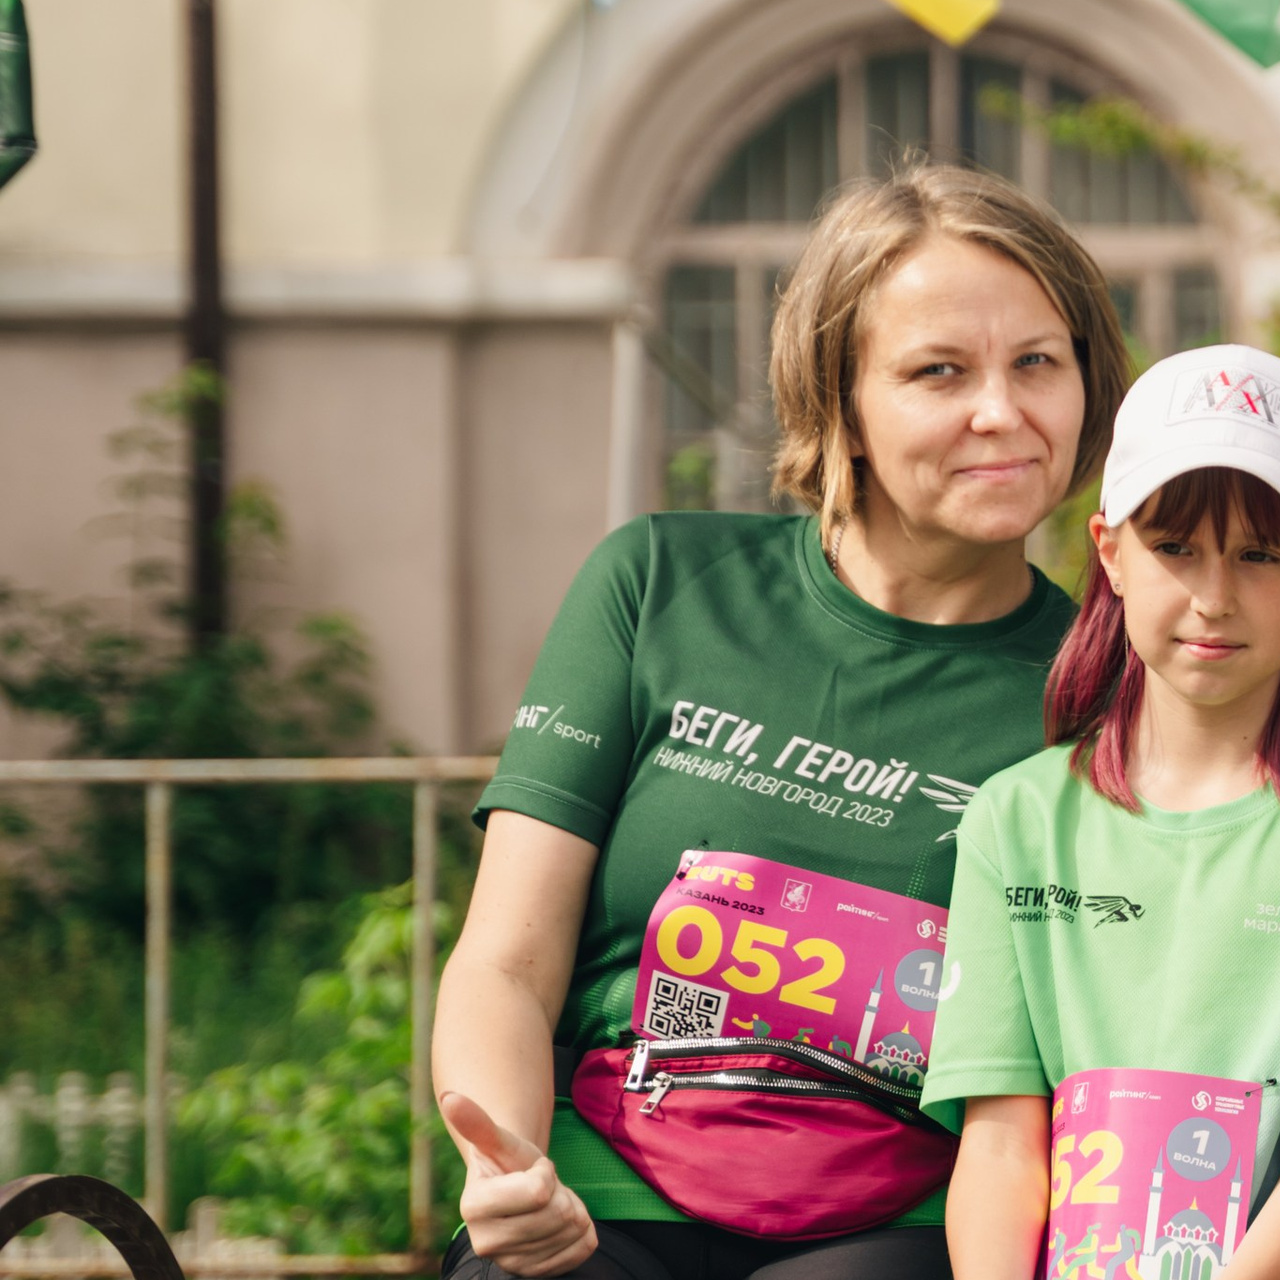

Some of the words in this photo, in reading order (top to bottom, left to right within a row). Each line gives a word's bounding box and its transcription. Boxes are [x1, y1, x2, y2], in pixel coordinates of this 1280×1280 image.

[669, 700, 764, 766] БЕГИ,
[773, 735, 919, 803] ГЕРОЙ!
[653, 746, 734, 783] НИЖНИЙ
[731, 768, 844, 817] НОВГОРОД
[842, 801, 894, 827] 2023
[685, 865, 755, 892] RUTS
[676, 886, 730, 906] КАЗАНЬ
[732, 900, 765, 916] 2023
[1005, 886, 1049, 910] БЕГИ,
[656, 905, 846, 1015] 052
[918, 961, 936, 987] 1
[1192, 1129, 1210, 1156] 1
[1050, 1130, 1124, 1211] 52
[1173, 1151, 1216, 1171] ВОЛНА
